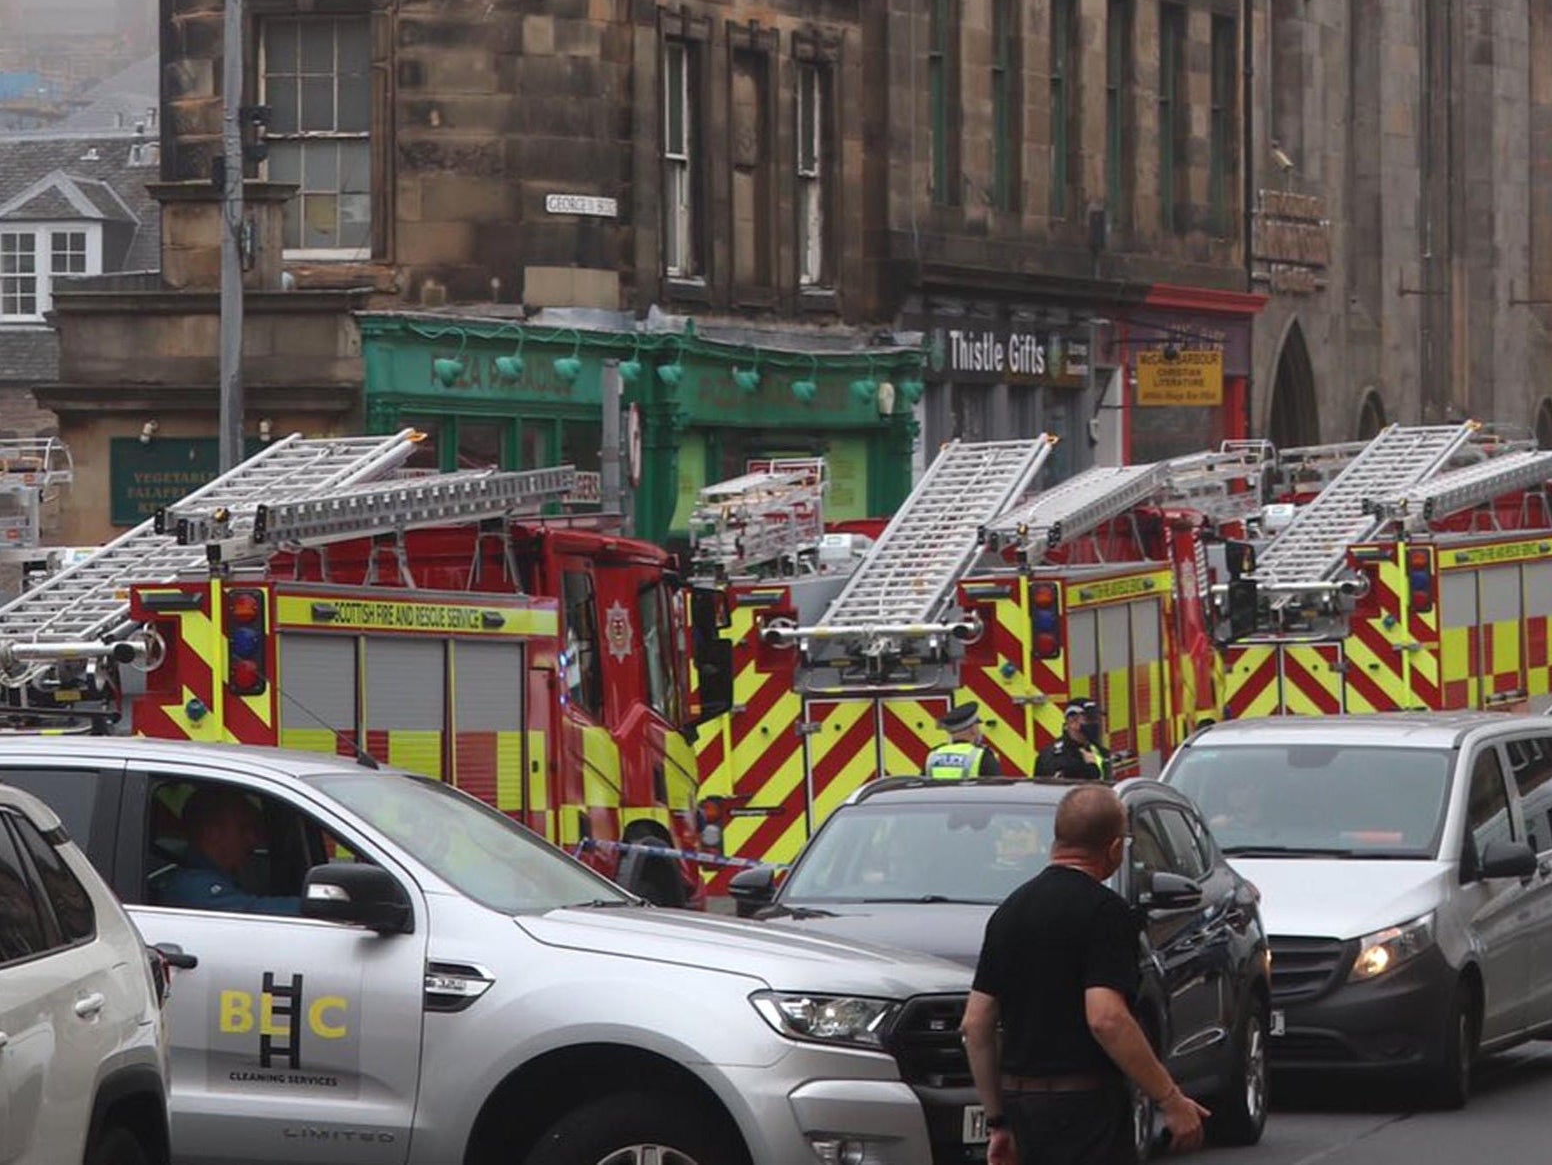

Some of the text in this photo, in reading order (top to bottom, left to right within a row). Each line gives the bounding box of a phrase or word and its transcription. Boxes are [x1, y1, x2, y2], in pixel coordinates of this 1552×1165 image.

[950, 330, 1045, 375] Thistle Gifts
[376, 604, 394, 625] FIRE
[396, 605, 413, 626] AND
[415, 606, 446, 627] RESCUE
[447, 607, 479, 628] SERVICE
[229, 1071, 338, 1087] CLEANING SERVICES
[283, 1127, 395, 1144] LIMITED
